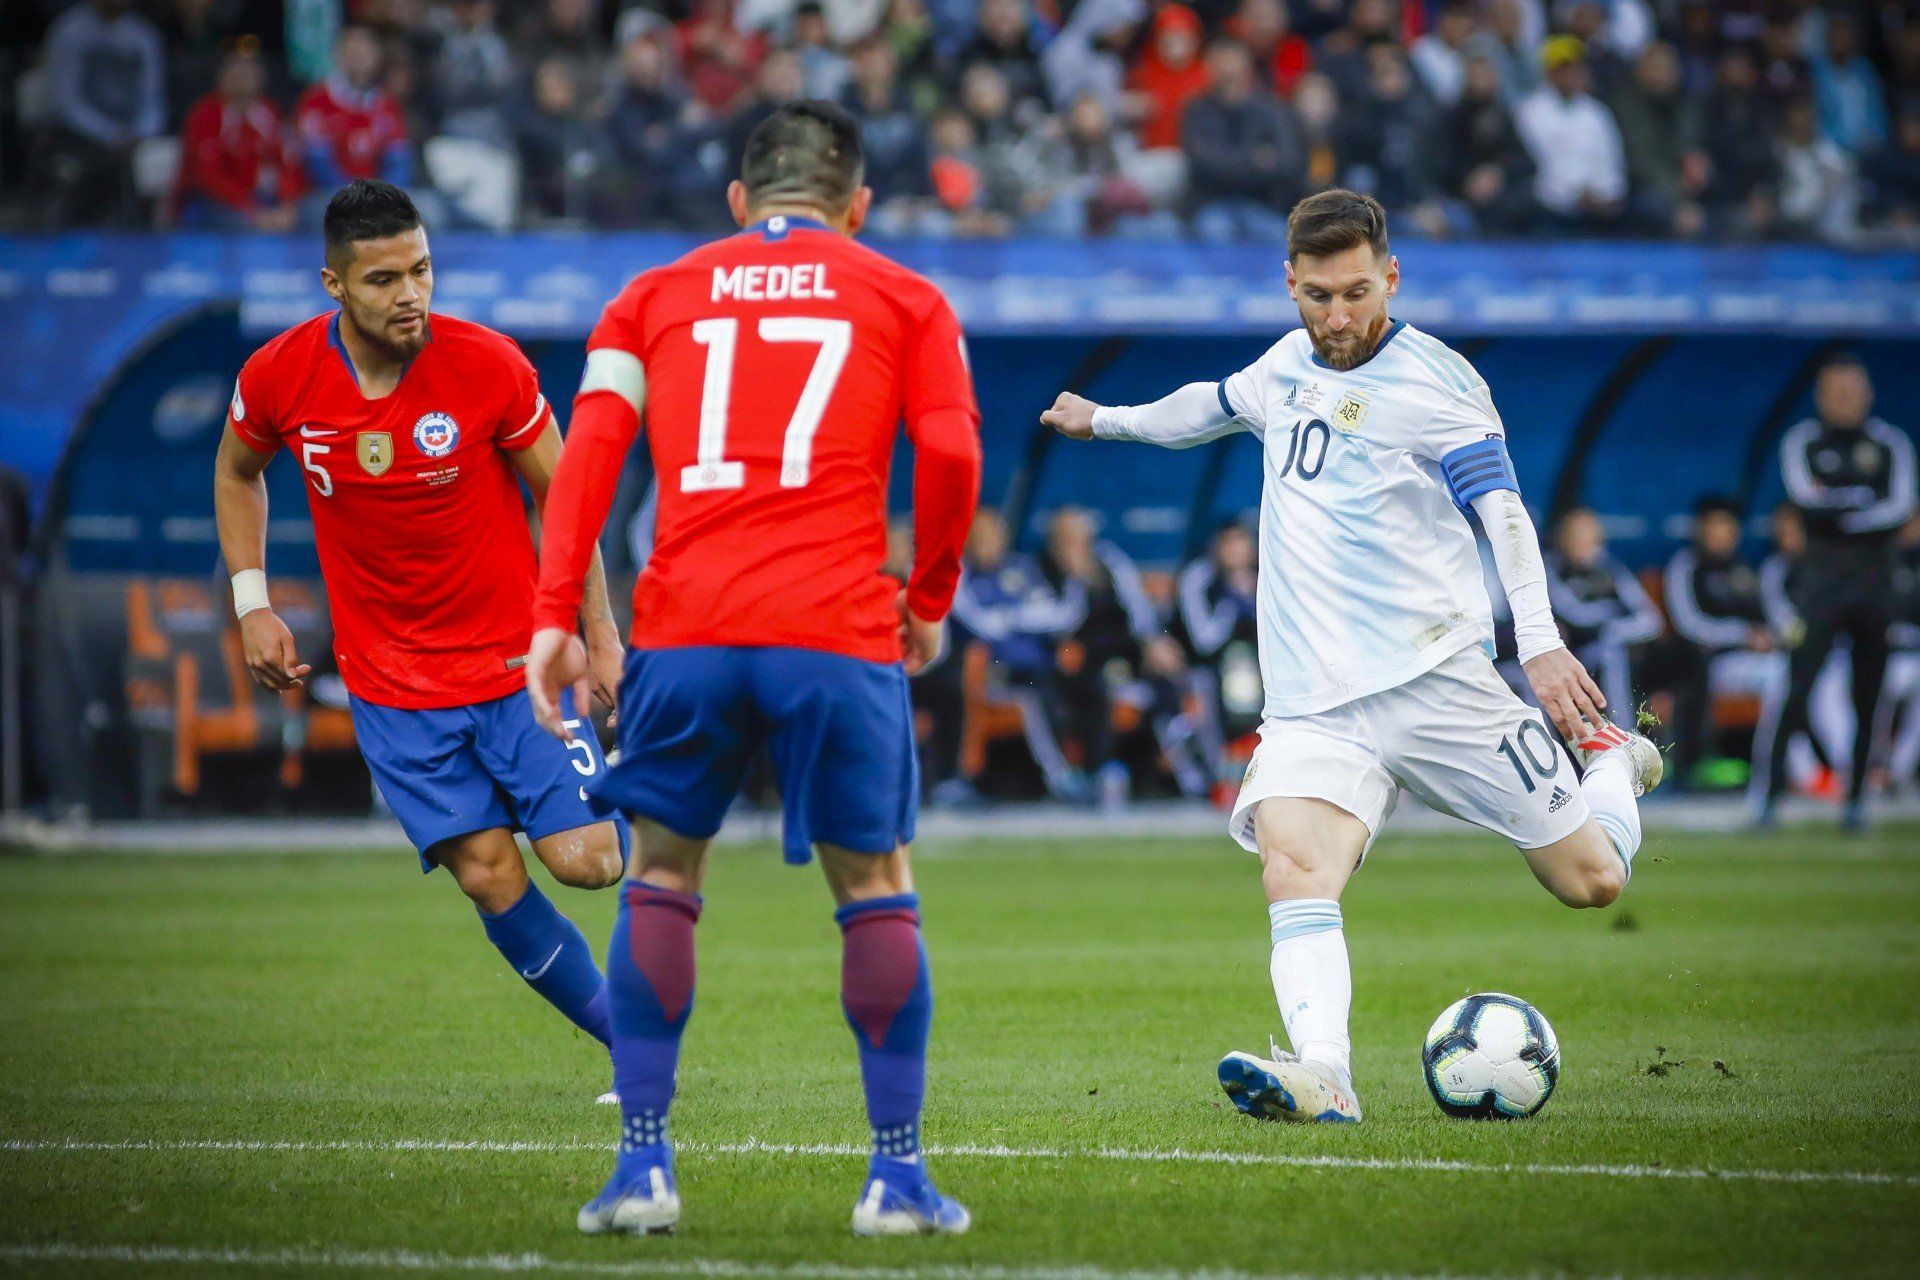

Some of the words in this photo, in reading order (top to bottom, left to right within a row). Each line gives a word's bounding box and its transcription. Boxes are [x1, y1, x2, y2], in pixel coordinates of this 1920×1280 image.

[711, 263, 837, 302] MEDEL
[680, 317, 852, 493] 17
[302, 442, 333, 497] 5
[1280, 418, 1330, 481] 10
[561, 718, 596, 777] 5
[1497, 719, 1558, 794] 10
[1548, 793, 1573, 813] adidas
